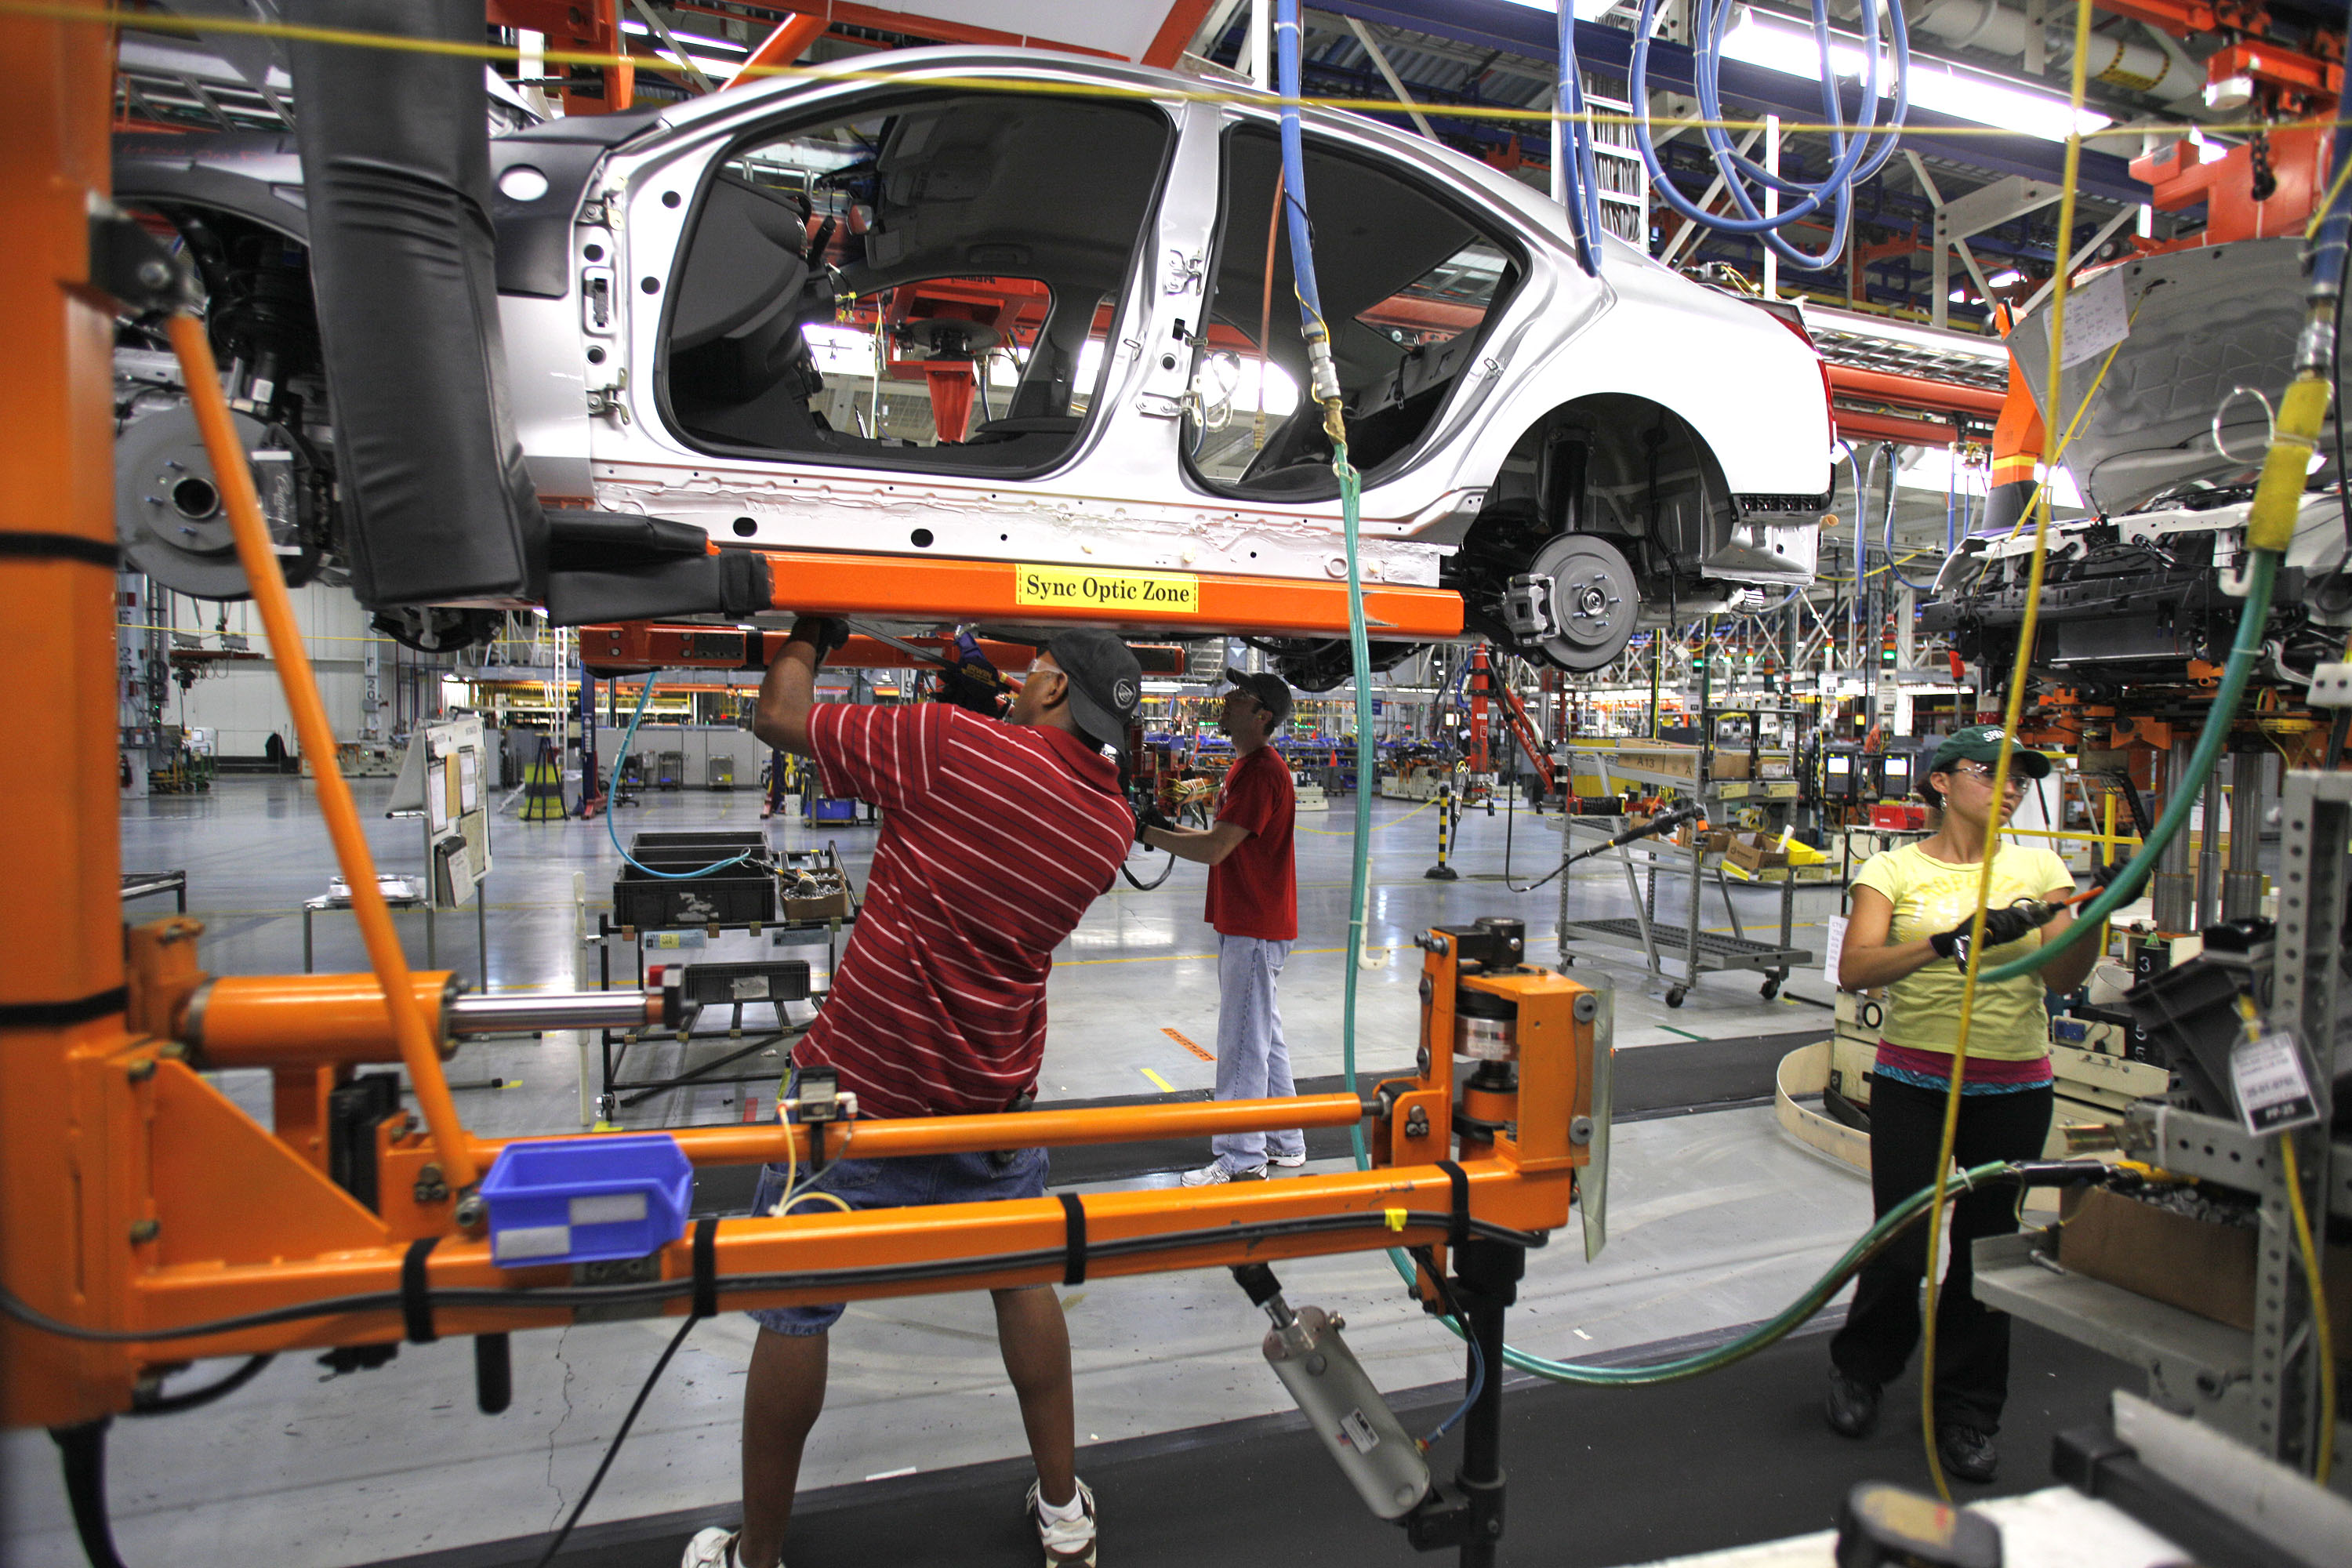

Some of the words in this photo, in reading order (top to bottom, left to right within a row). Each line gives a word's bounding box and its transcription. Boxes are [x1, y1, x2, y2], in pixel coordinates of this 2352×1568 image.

[1026, 574, 1077, 600] Sync
[1082, 577, 1137, 603] Optic
[1142, 580, 1190, 603] Zone
[367, 657, 376, 666] F
[966, 663, 993, 680] IRWIN
[367, 680, 376, 700] 20
[2139, 956, 2151, 973] 3
